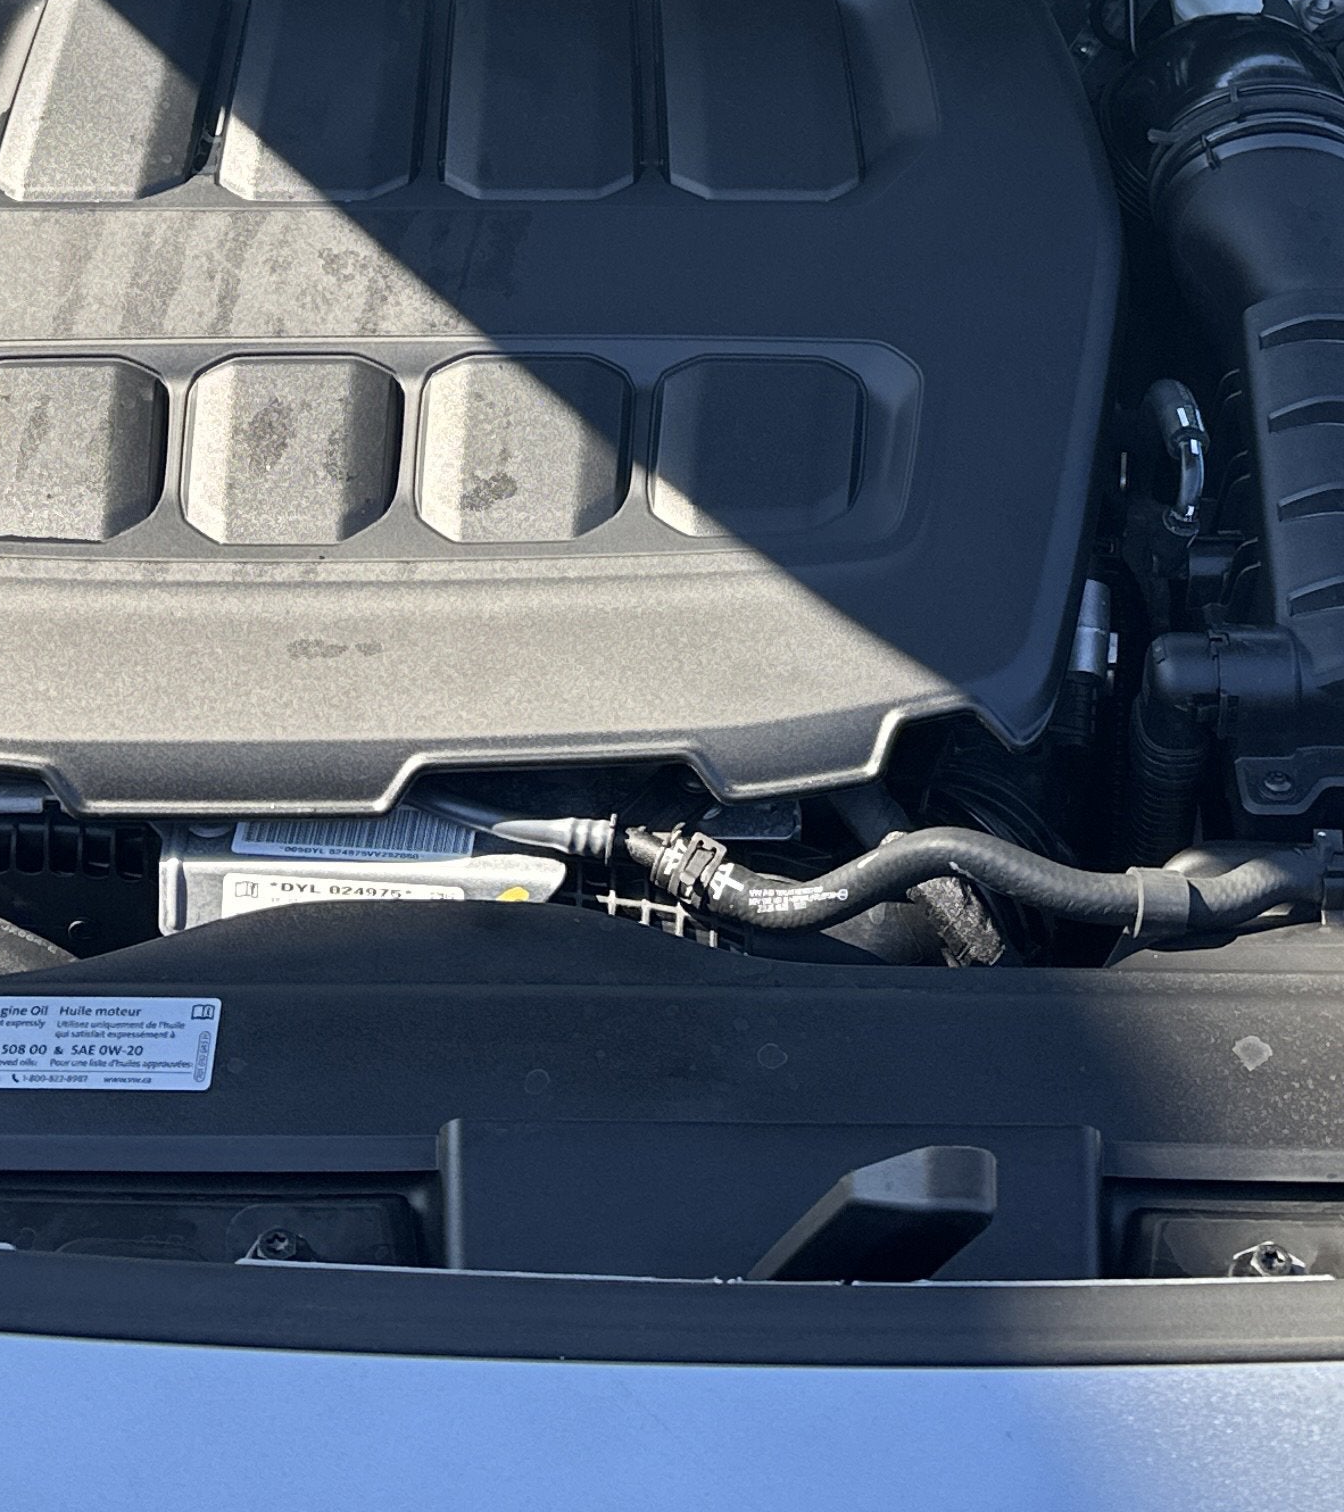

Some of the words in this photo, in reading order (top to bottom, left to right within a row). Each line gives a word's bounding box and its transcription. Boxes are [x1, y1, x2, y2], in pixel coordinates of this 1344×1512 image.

[31, 1005, 49, 1016] Oil
[59, 1006, 92, 1016] Huile
[95, 1007, 142, 1016] moteur
[6, 1019, 46, 1029] expressly
[57, 1021, 89, 1029] Utilisez
[91, 1021, 144, 1031] uniquement
[146, 1021, 156, 1029] de
[55, 1031, 69, 1039] qui
[107, 1031, 168, 1039] expressément
[1, 1044, 26, 1055] 508
[29, 1045, 47, 1055] 00
[53, 1046, 64, 1055] &
[71, 1045, 96, 1055] SAE
[99, 1044, 144, 1056] 0W-20
[50, 1059, 69, 1067] Pour
[89, 1059, 106, 1067] liste
[108, 1059, 141, 1068] d'huiles
